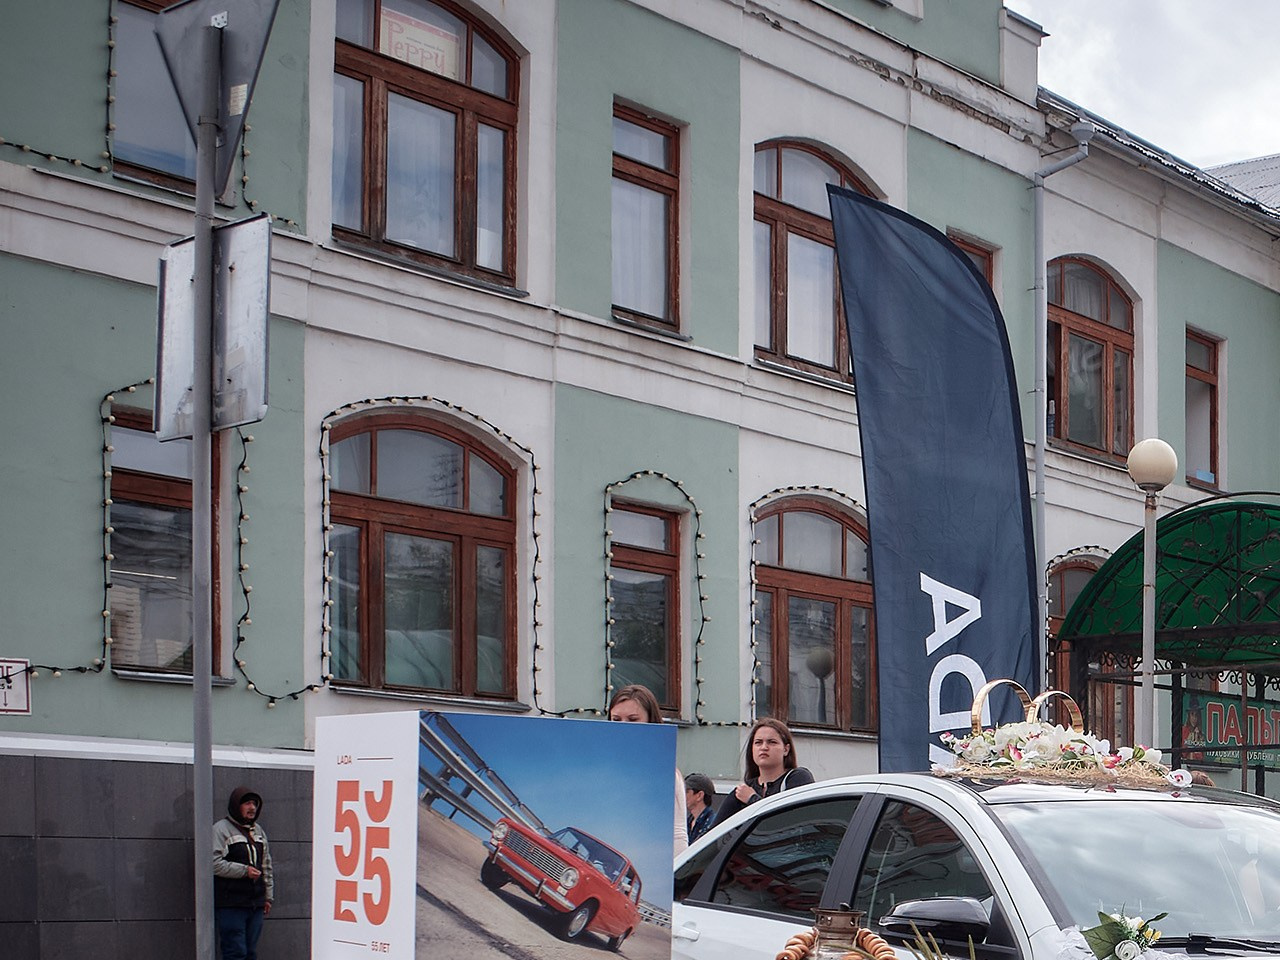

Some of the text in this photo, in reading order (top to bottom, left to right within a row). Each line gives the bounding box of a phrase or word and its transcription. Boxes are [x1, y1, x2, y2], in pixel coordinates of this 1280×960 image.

[337, 755, 352, 765] LADA
[371, 940, 391, 953] 55 ЛЕТ
